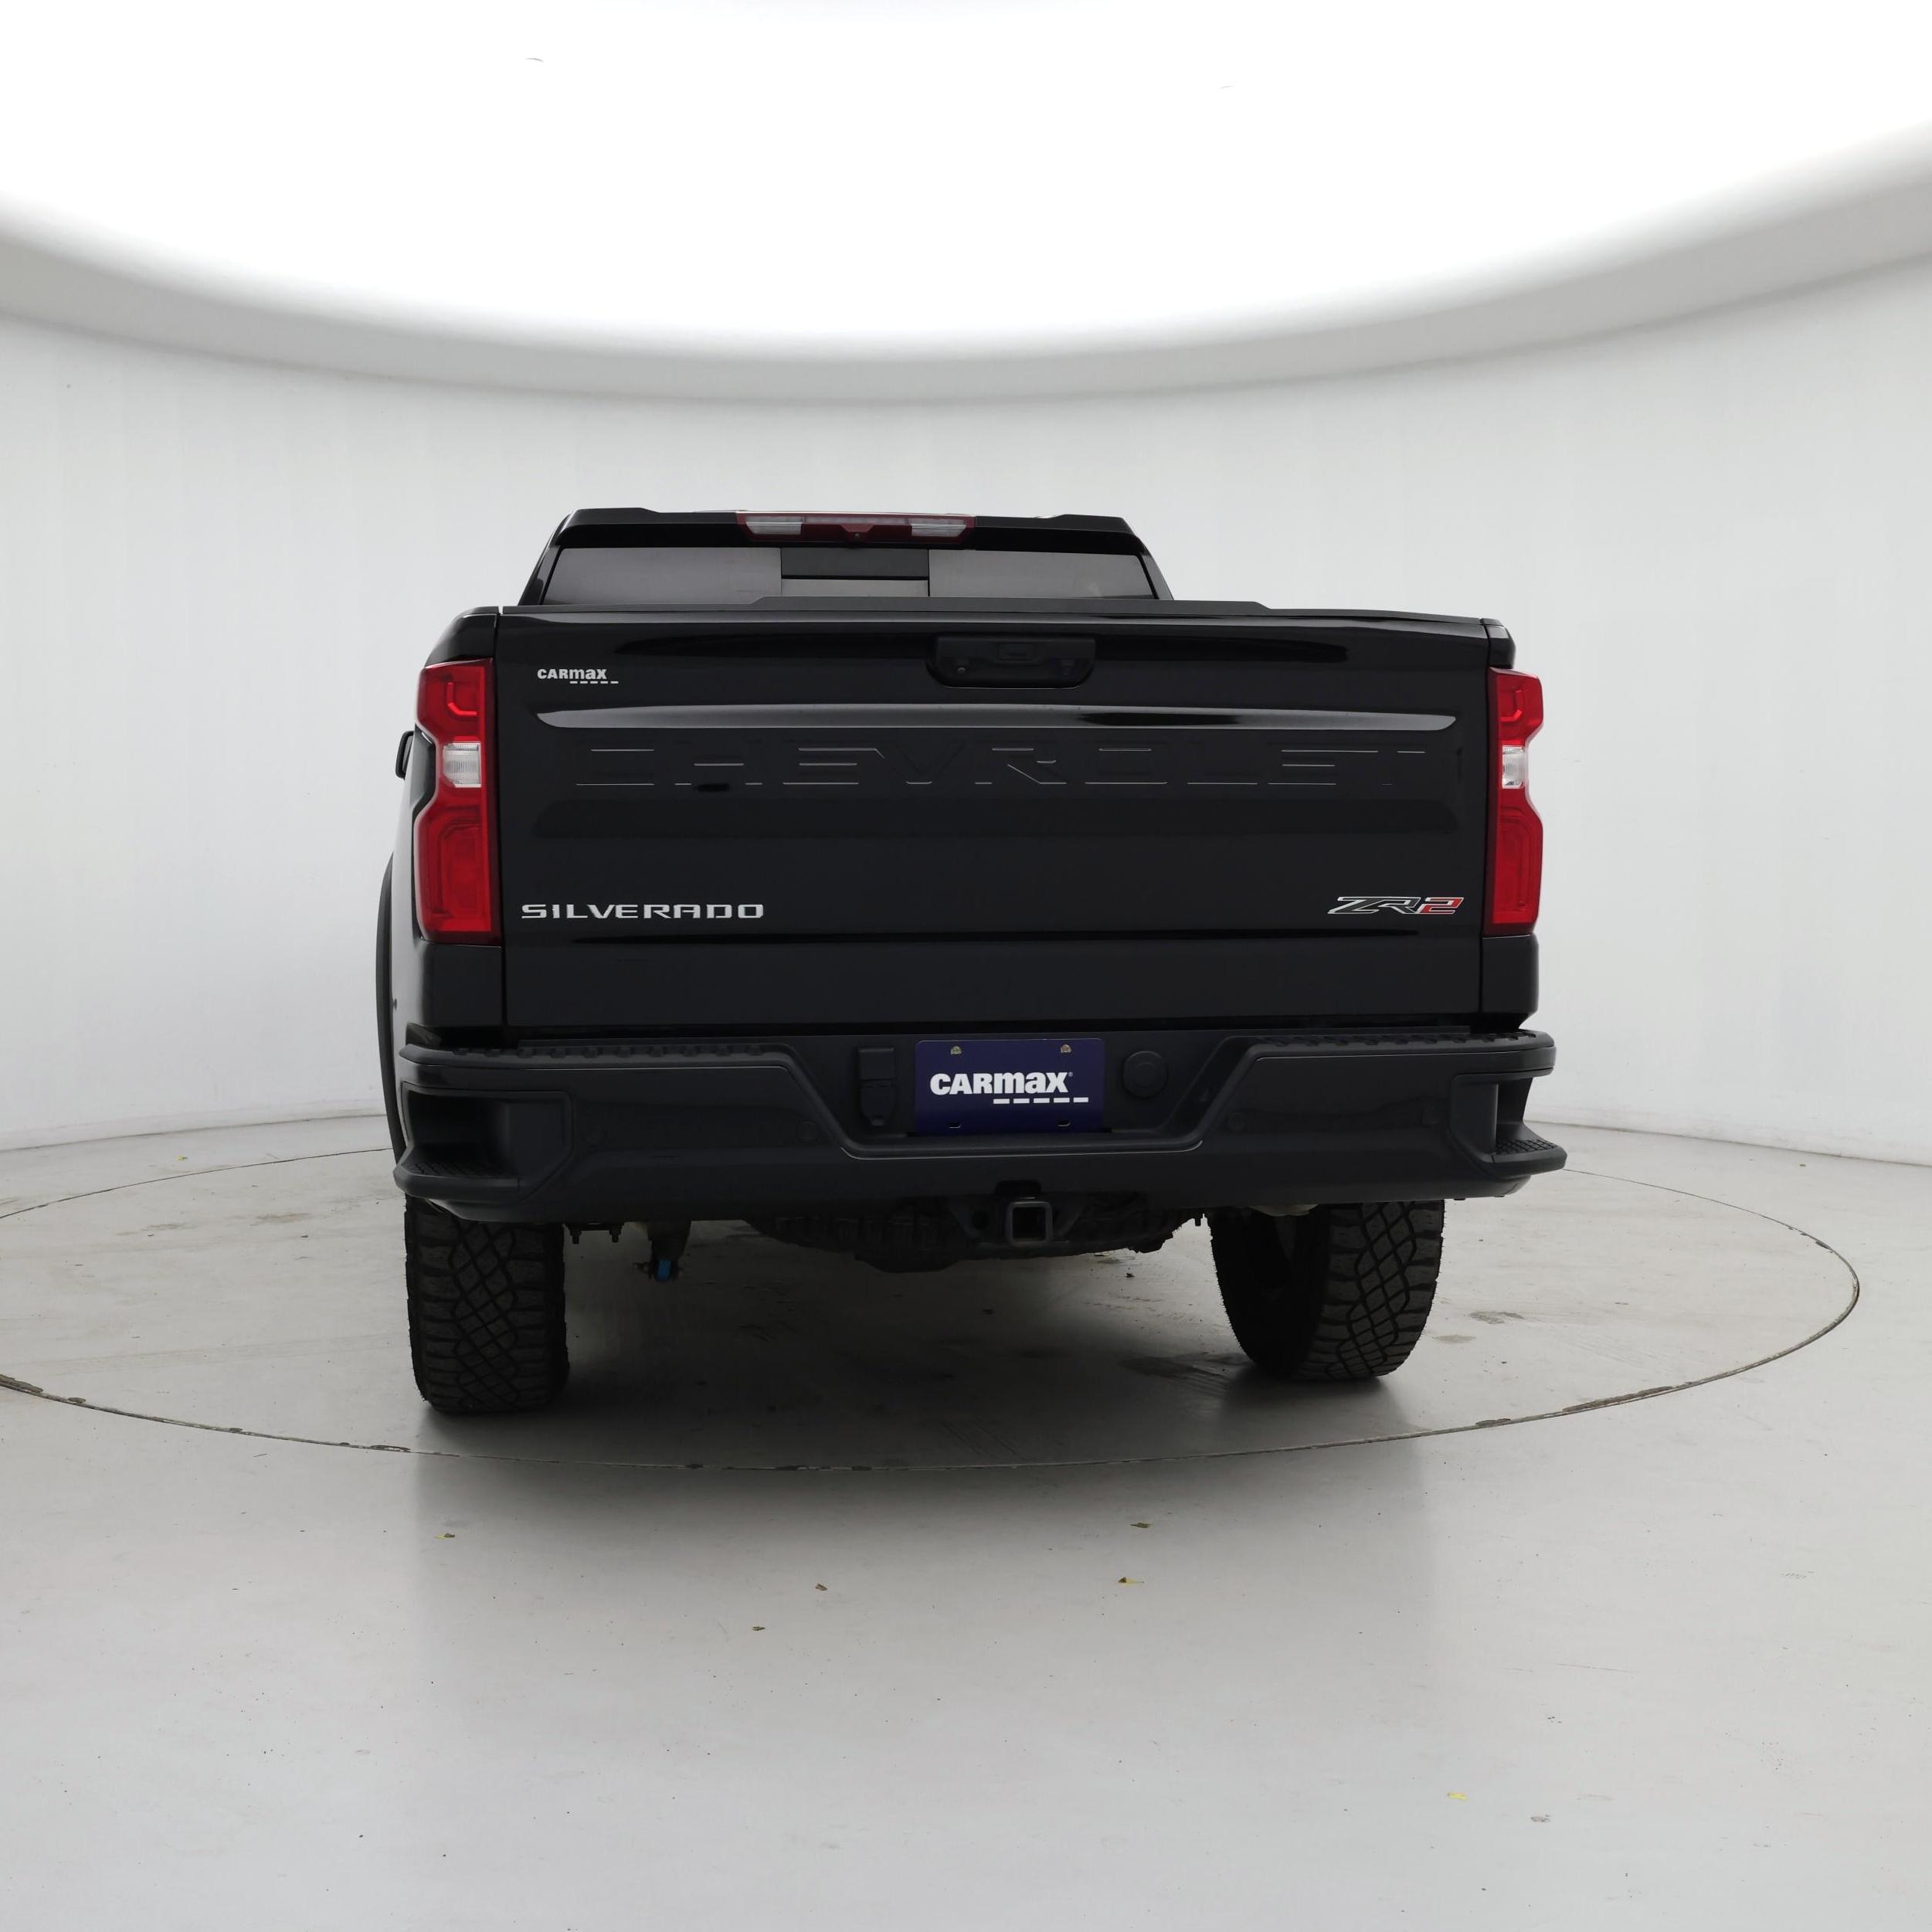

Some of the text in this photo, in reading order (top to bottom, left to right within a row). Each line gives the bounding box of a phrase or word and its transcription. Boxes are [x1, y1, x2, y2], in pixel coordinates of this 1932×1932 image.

[576, 741, 1427, 786] CHEVROLET
[521, 904, 764, 919] SILVERADO
[1327, 896, 1465, 915] ZR2
